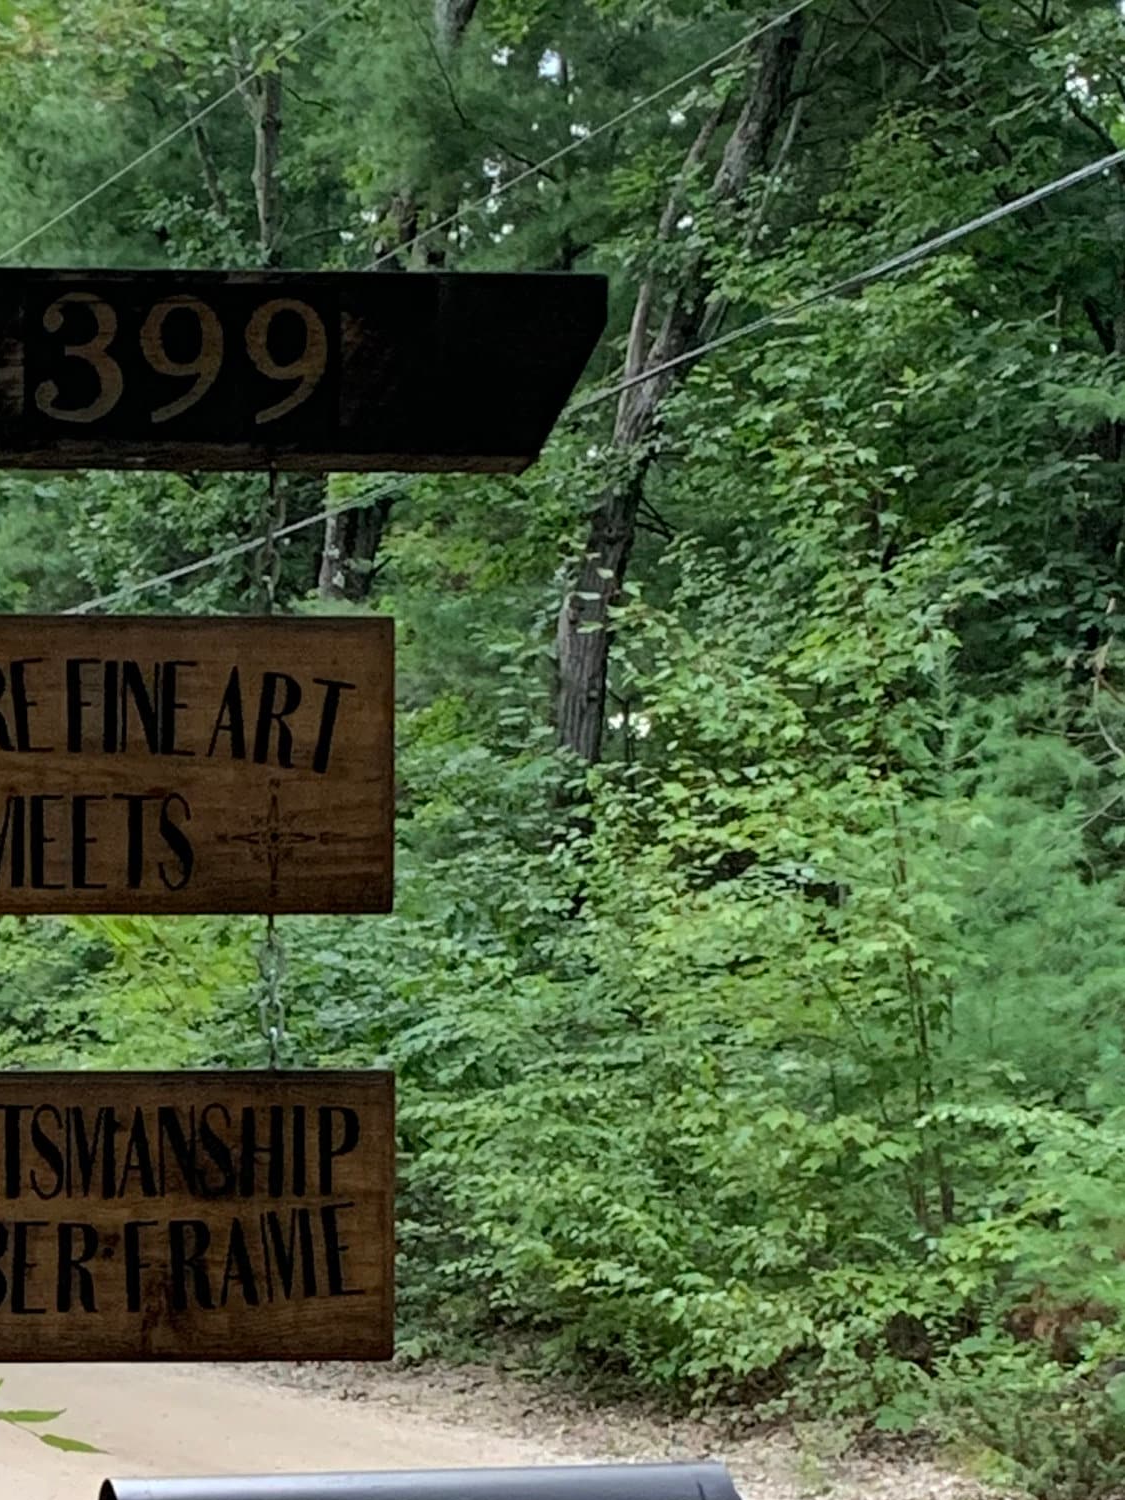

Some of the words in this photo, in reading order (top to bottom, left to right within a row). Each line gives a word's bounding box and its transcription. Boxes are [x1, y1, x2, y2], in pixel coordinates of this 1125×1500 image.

[34, 292, 328, 424] 399
[65, 657, 197, 758] FINE
[208, 665, 356, 774] ART
[124, 1202, 366, 1313] FRAME
